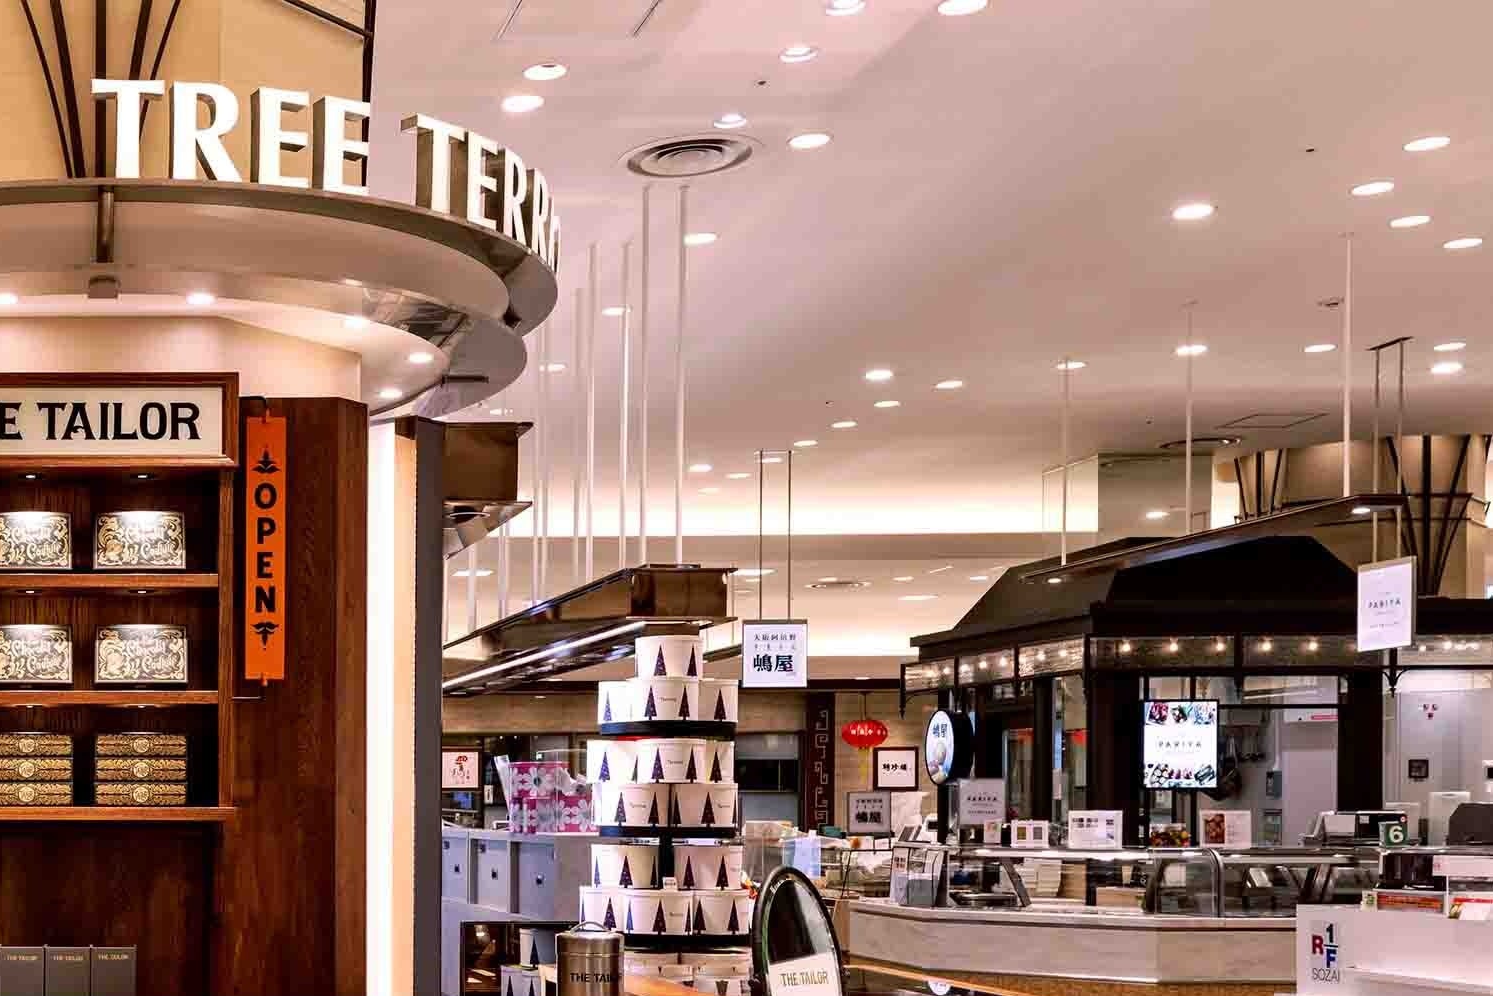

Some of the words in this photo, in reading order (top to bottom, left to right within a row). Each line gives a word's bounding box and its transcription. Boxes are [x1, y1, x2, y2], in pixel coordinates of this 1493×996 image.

[92, 79, 370, 196] TREE
[36, 401, 201, 441] TAILOR
[254, 482, 277, 613] OPEN
[1388, 825, 1404, 843] 6
[570, 973, 591, 983] THE
[779, 973, 798, 987] THE
[800, 971, 829, 985] TAILOR
[1312, 967, 1340, 982] SOZAI
